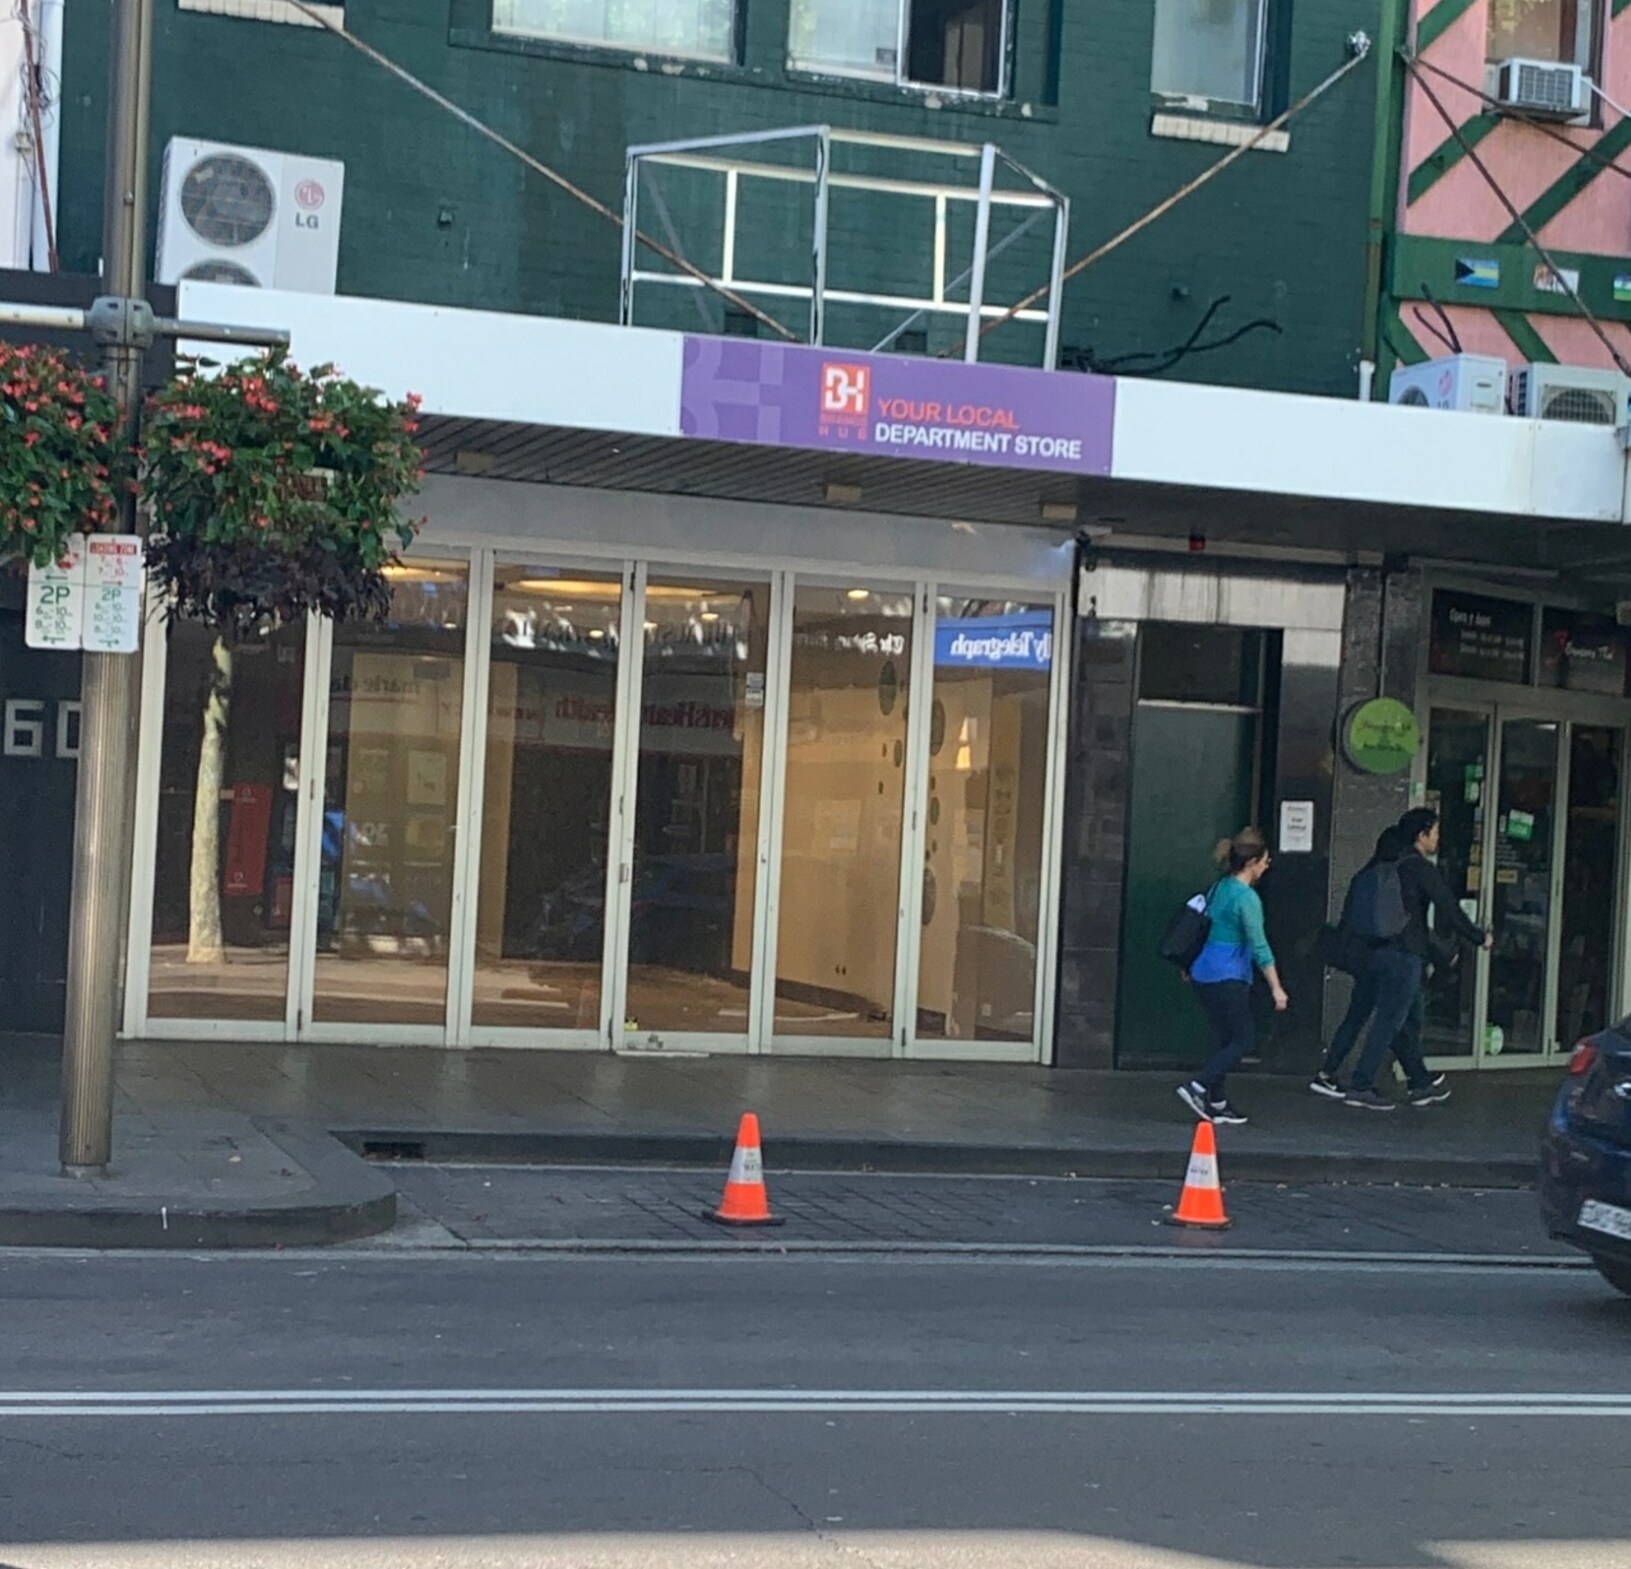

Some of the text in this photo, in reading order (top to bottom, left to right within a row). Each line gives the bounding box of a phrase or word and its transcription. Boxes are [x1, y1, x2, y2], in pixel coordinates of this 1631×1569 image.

[295, 211, 320, 230] LG
[877, 398, 941, 423] YOUR
[947, 404, 1020, 430] LOCAL
[875, 421, 1082, 460] DEPARTMENT STORE
[39, 584, 71, 605] 2P
